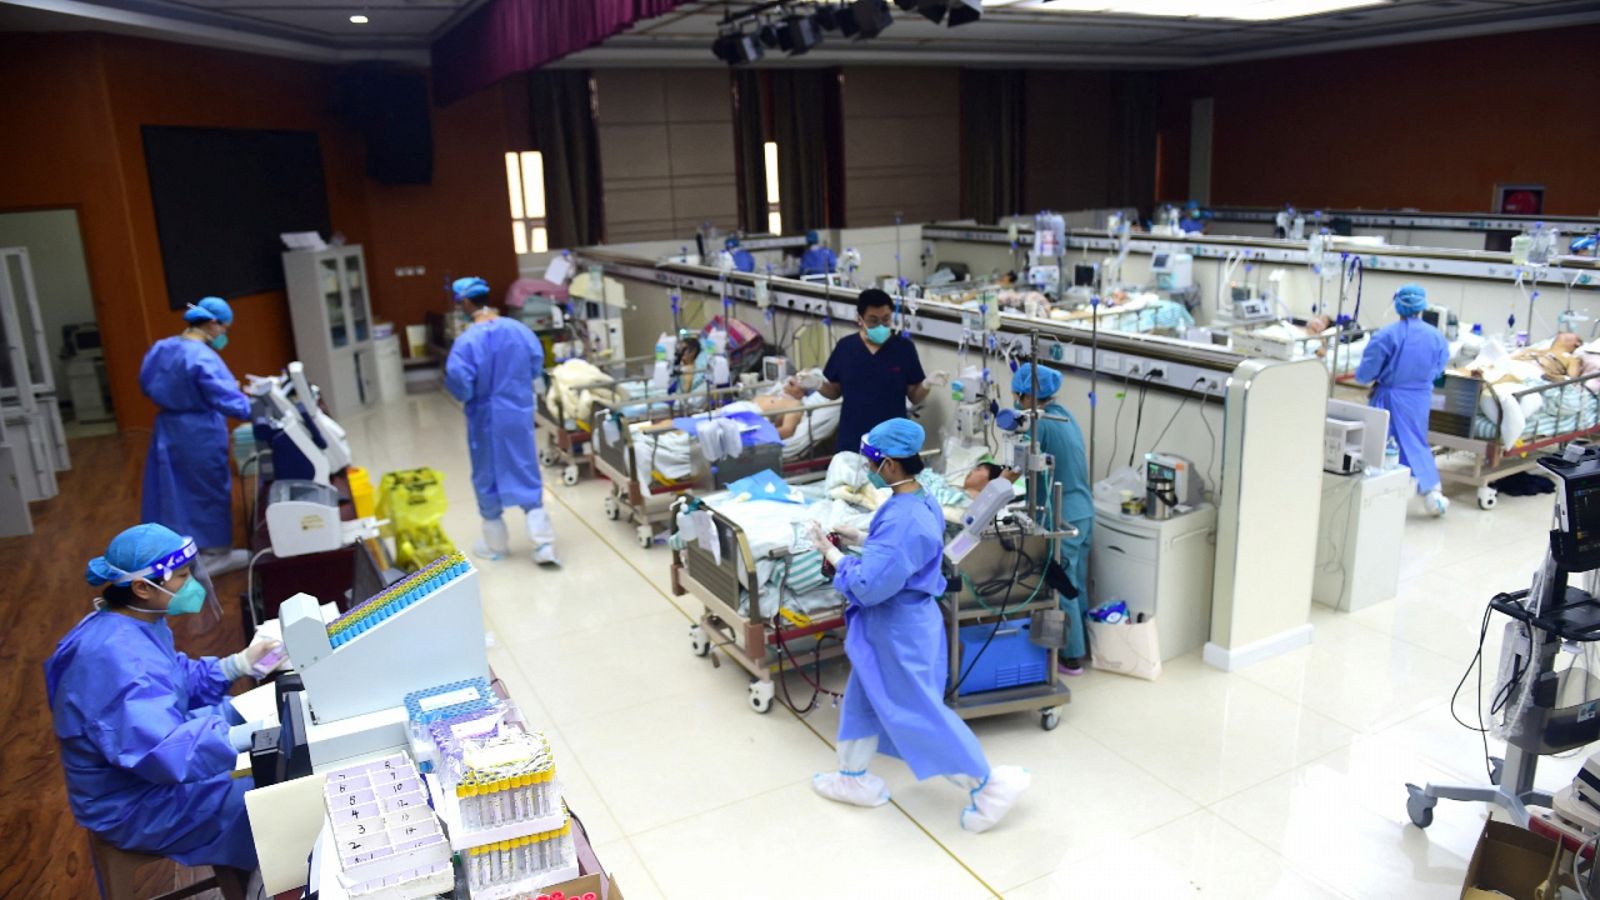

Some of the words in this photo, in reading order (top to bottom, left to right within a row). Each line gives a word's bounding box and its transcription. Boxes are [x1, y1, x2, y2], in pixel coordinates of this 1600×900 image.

[340, 784, 347, 793] 6
[393, 783, 403, 793] 10
[352, 809, 359, 819] 4
[357, 824, 366, 834] 3
[406, 827, 417, 836] 14
[348, 841, 362, 850] 2
